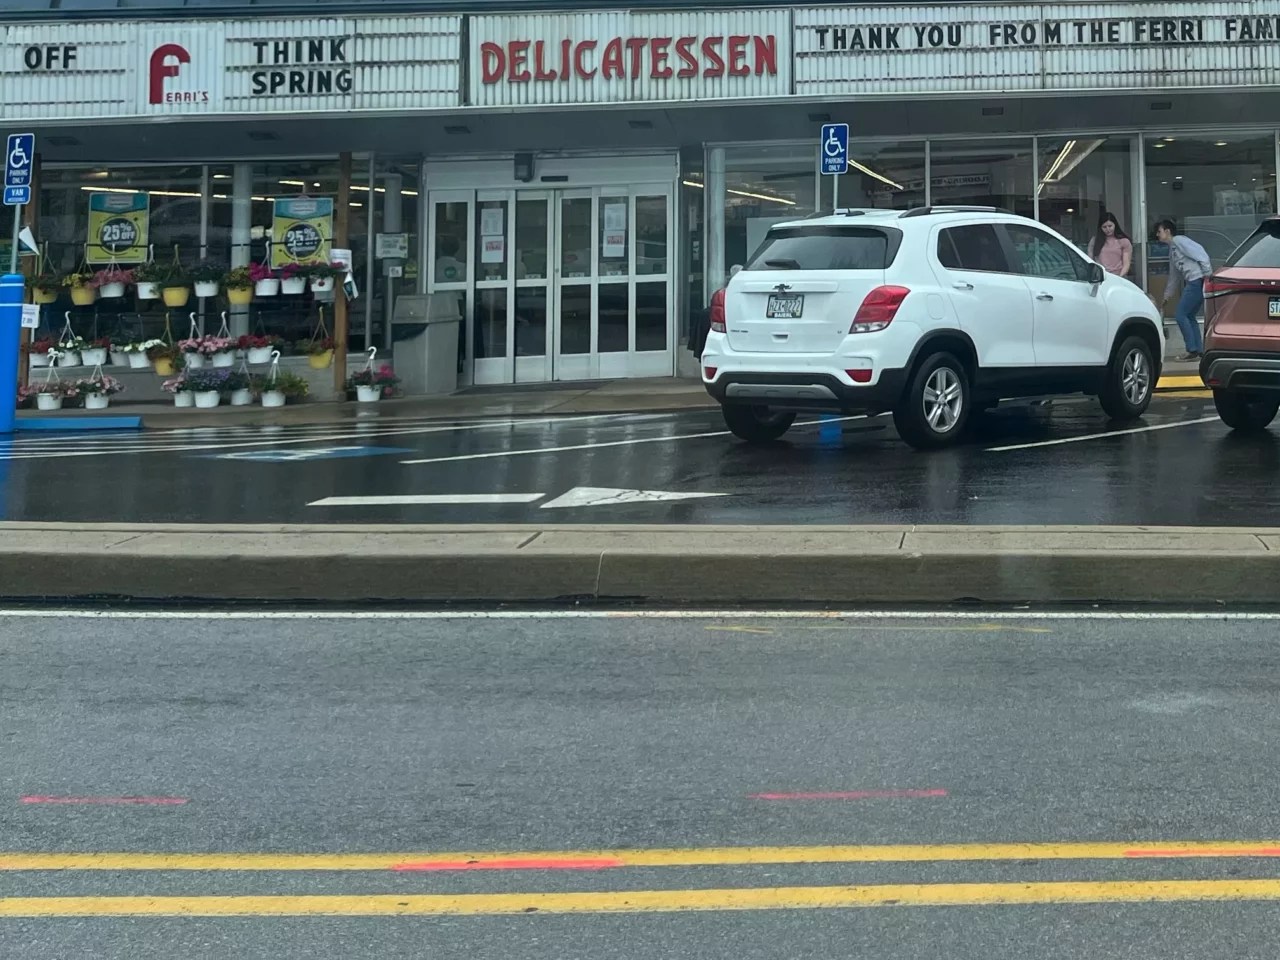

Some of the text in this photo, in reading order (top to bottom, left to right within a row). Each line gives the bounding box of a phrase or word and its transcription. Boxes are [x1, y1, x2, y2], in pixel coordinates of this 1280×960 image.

[816, 27, 900, 50] THANK
[914, 25, 962, 48] YOU
[989, 23, 1061, 46] FROM
[1074, 21, 1119, 44] THE
[1134, 19, 1202, 42] FERRI
[24, 46, 77, 70] OFF
[253, 40, 346, 64] THINK
[481, 35, 778, 85] DELICATESSEN
[252, 69, 353, 95] SPRING
[11, 188, 24, 196] VAN
[103, 223, 135, 241] 25% OFF
